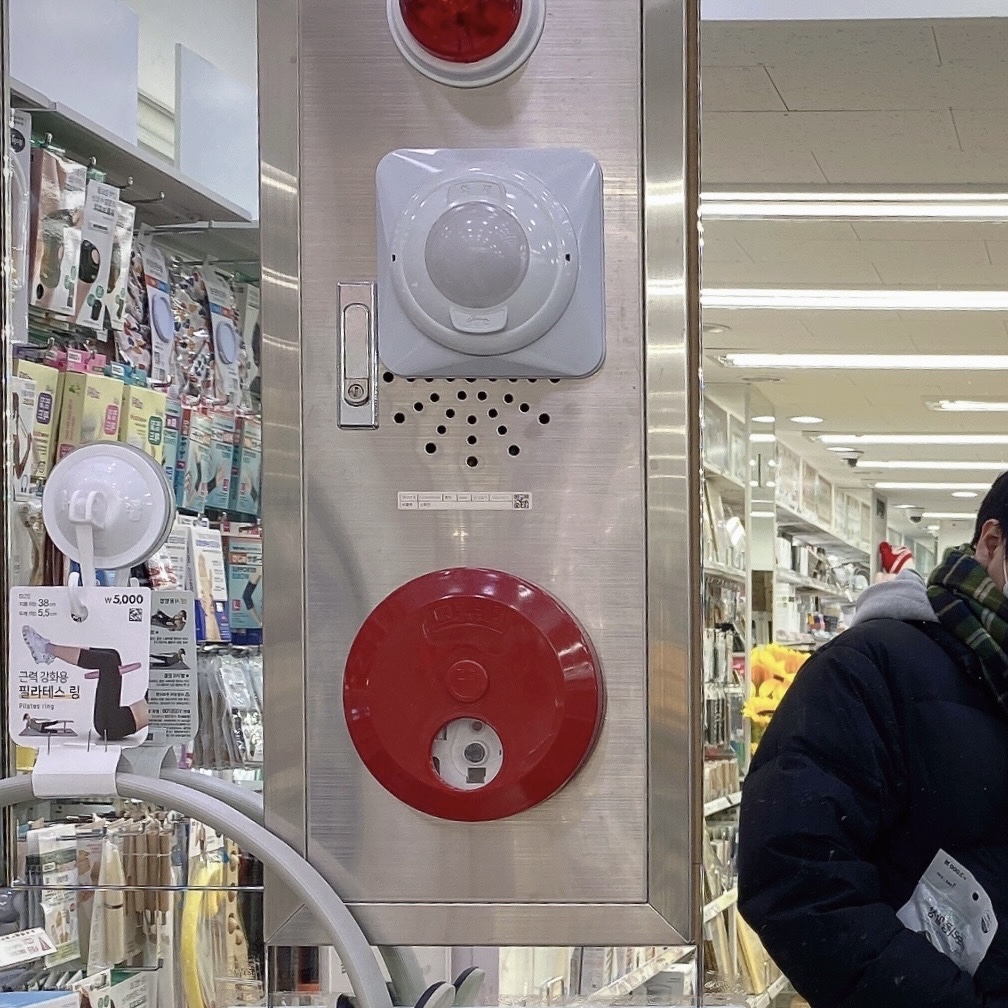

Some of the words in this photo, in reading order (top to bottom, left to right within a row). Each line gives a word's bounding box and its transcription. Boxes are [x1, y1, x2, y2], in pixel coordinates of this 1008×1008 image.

[18, 671, 40, 684] 근력
[41, 671, 69, 684] 강화용
[18, 686, 66, 699] 필라테스
[69, 686, 81, 699] 링
[41, 703, 55, 711] ring
